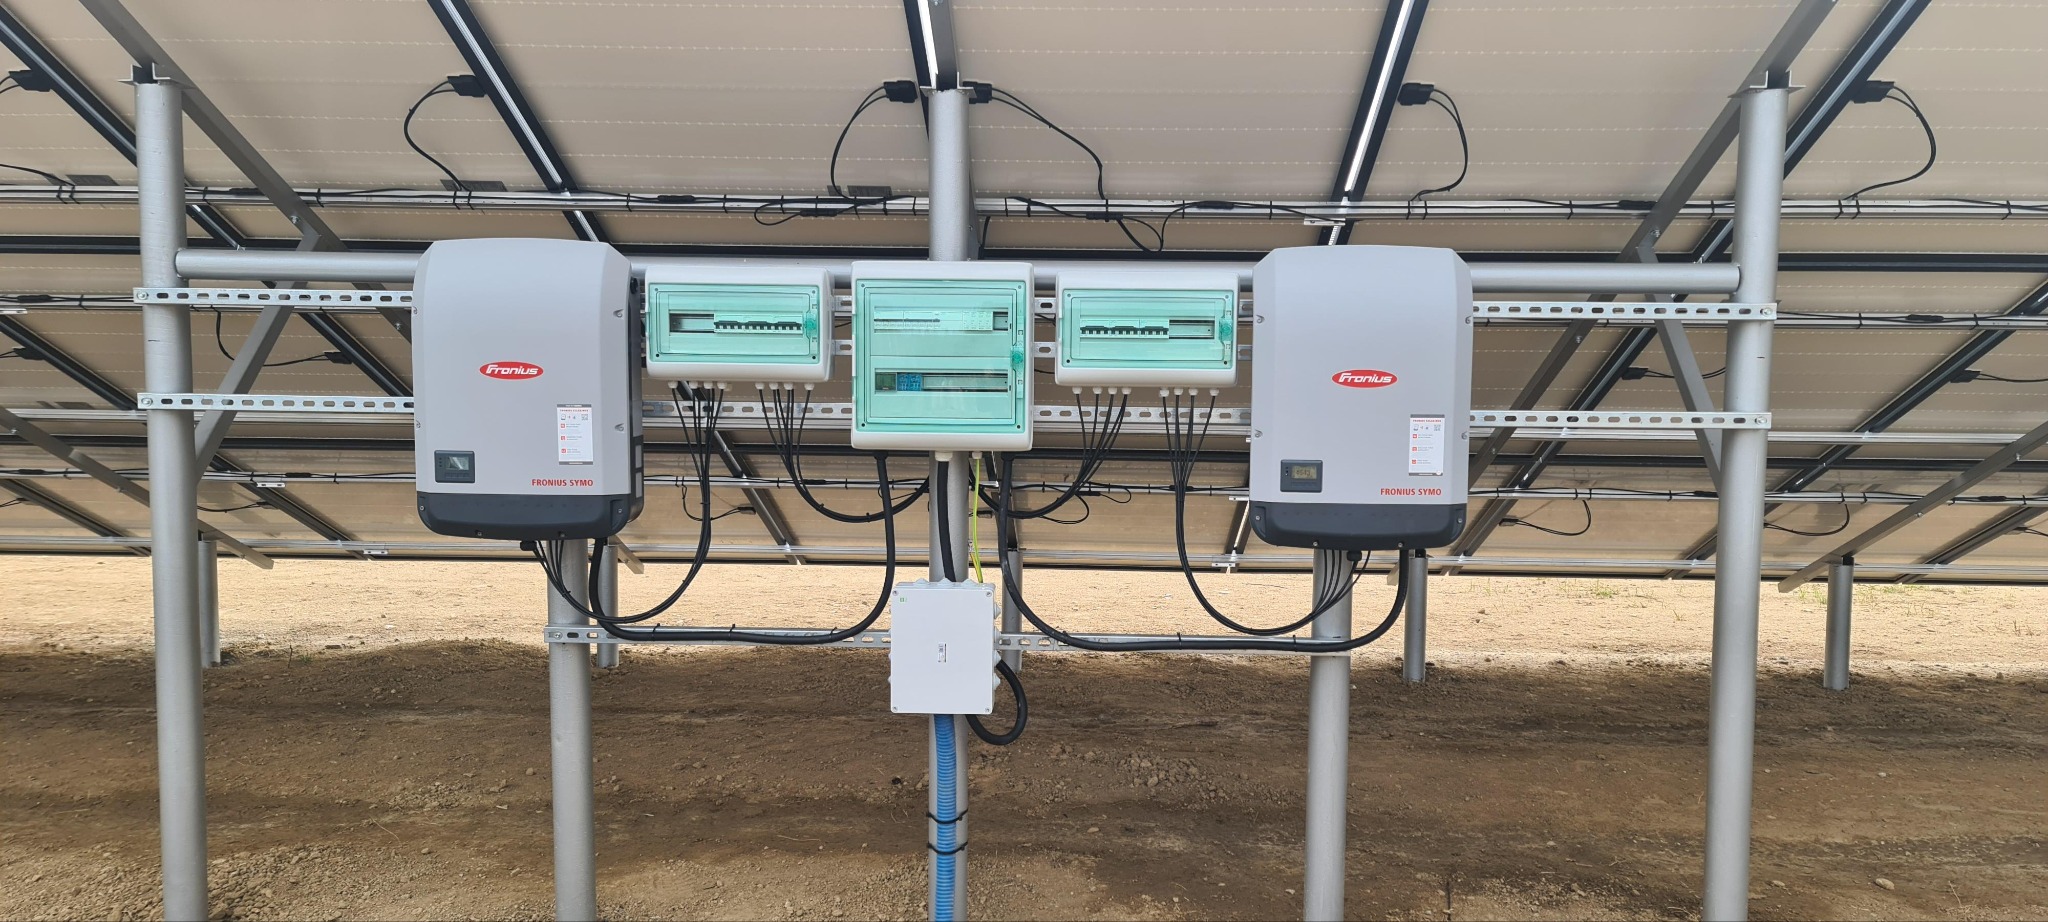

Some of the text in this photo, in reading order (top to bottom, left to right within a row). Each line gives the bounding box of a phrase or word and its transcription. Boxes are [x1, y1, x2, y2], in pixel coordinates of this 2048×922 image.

[485, 364, 538, 375] Fronius
[1338, 372, 1393, 383] Fronius
[531, 479, 594, 487] FRONIUS SYMO
[1380, 488, 1442, 496] FRONIUS SYMO
